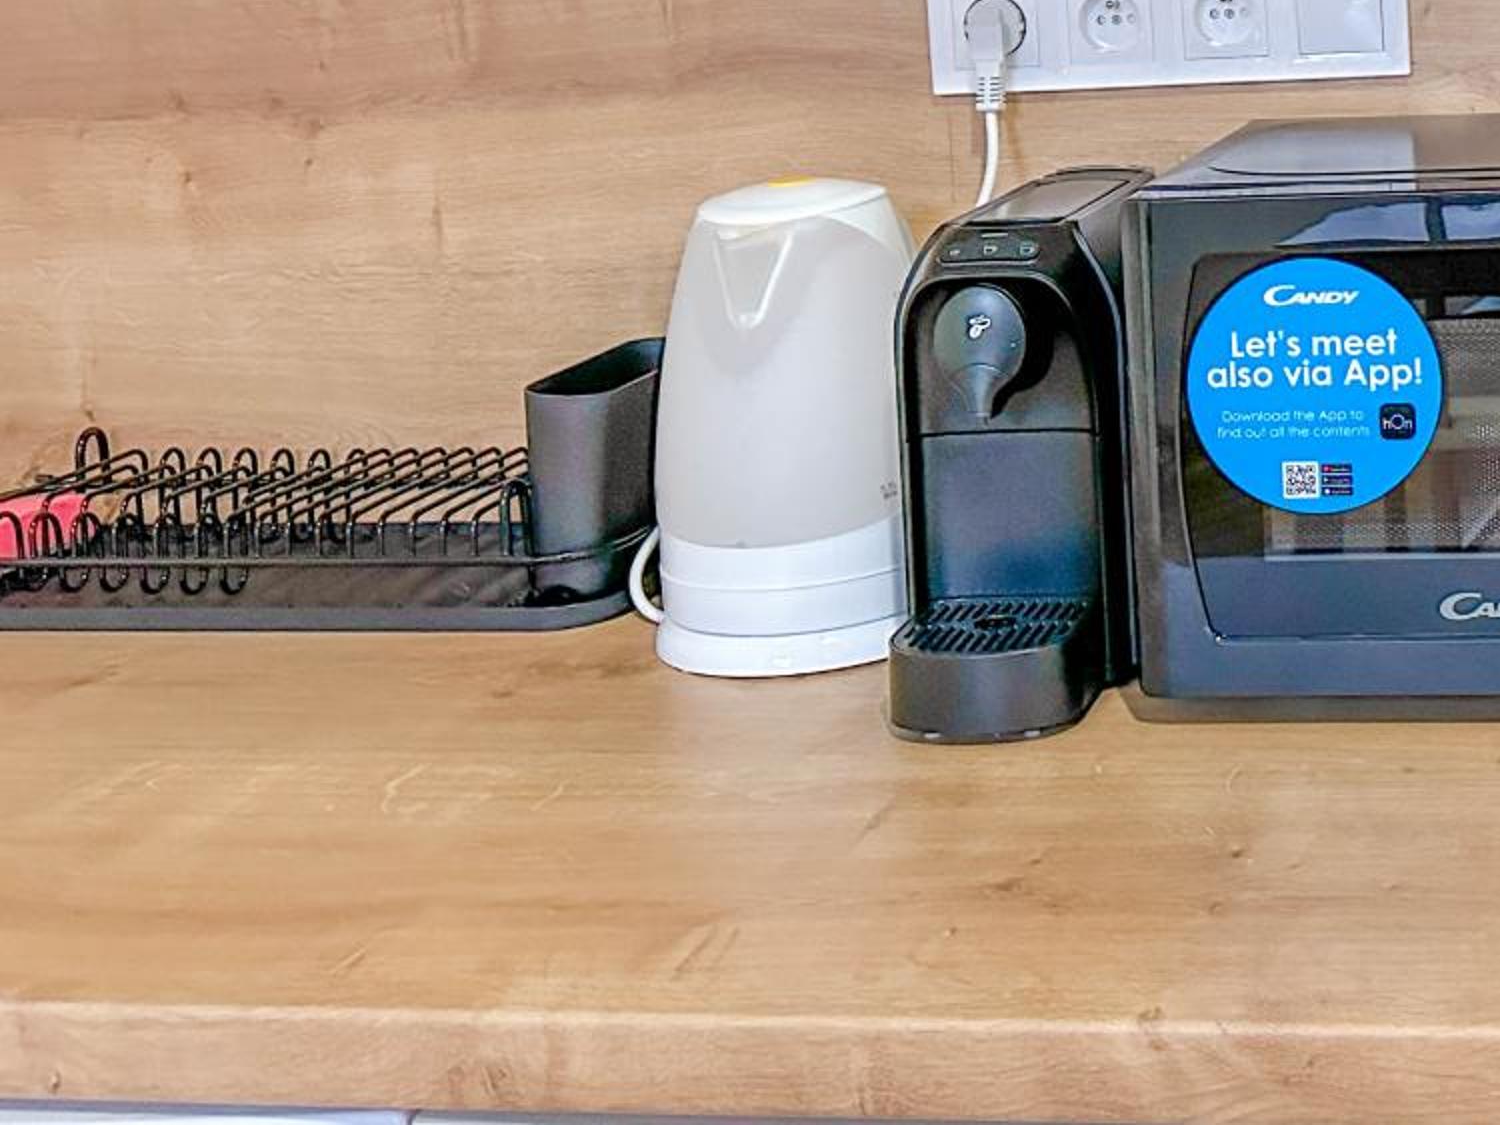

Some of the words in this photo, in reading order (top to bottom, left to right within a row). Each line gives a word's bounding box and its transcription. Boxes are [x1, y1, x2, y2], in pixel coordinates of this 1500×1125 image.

[1263, 284, 1360, 307] CANDY
[1231, 330, 1301, 358] Let's
[1312, 328, 1397, 356] meet
[1207, 361, 1273, 388] also
[1283, 359, 1333, 387] via
[1343, 357, 1423, 391] App!
[1221, 410, 1290, 423] Download
[1293, 409, 1315, 421] the
[1319, 410, 1347, 423] App
[1351, 410, 1365, 421] to
[1217, 426, 1241, 439] find
[1245, 427, 1267, 439] out
[1269, 426, 1285, 439] all
[1287, 425, 1309, 438] the
[1313, 425, 1371, 438] contents
